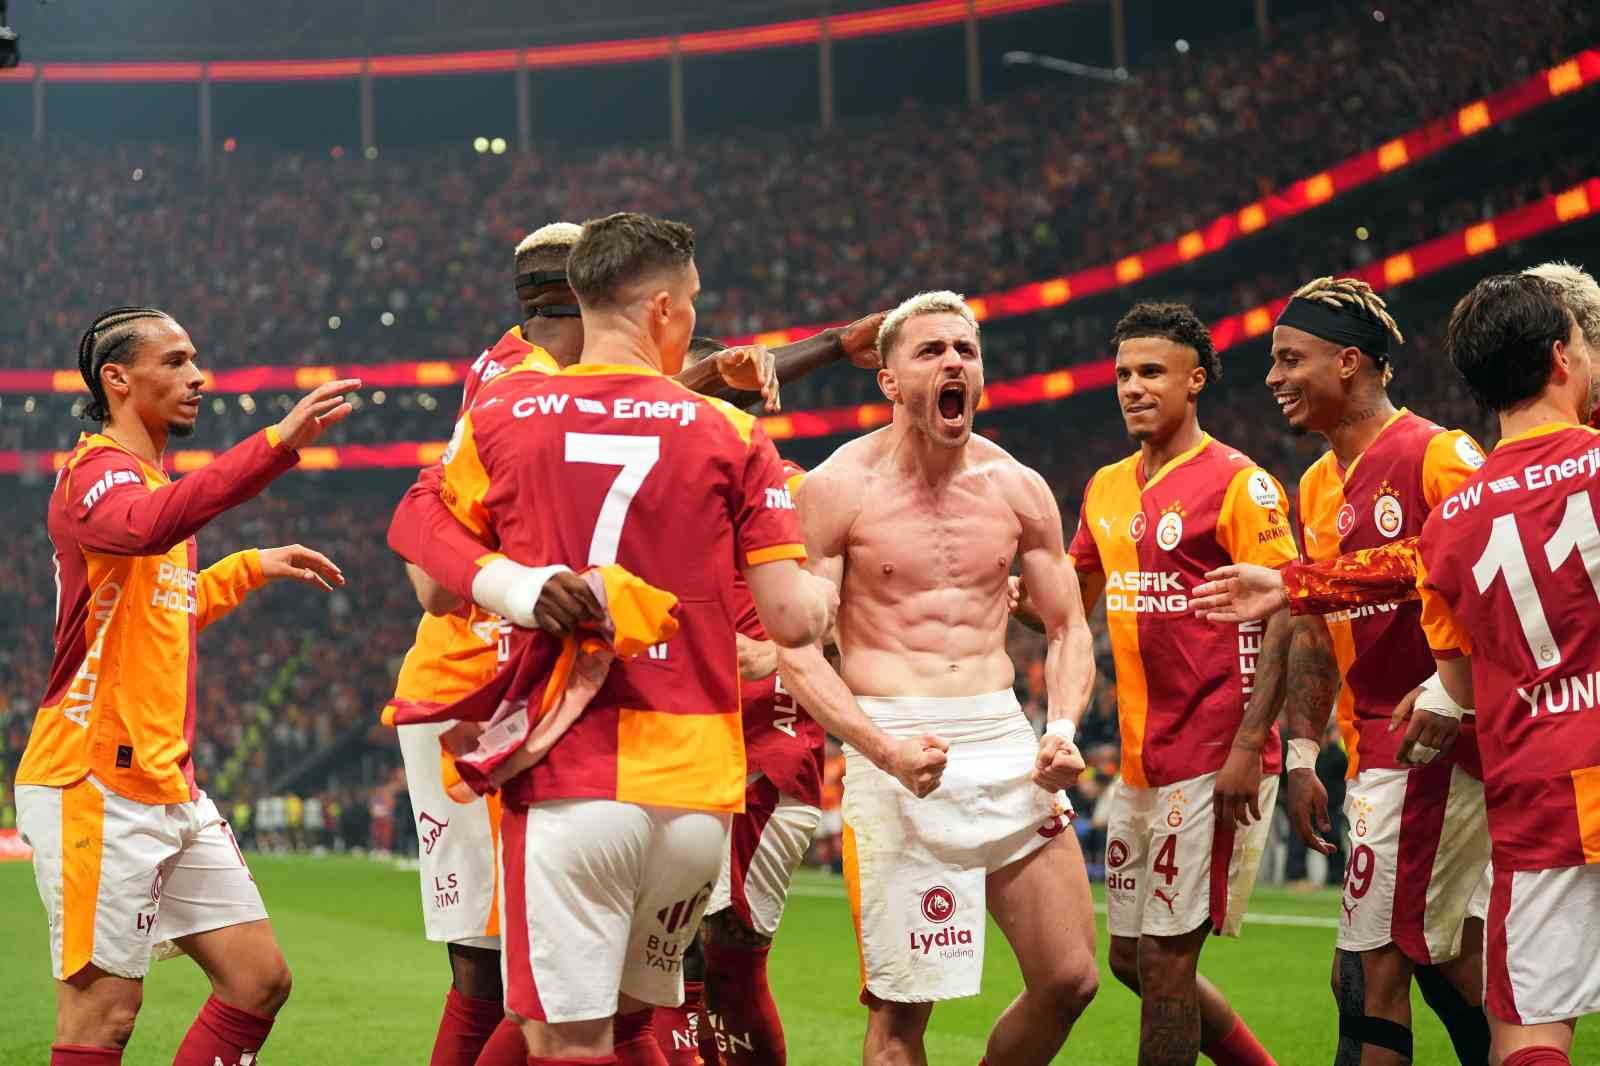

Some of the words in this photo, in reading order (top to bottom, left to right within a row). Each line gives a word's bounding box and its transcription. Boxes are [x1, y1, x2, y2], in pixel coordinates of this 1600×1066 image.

[512, 393, 569, 418] CW
[613, 398, 696, 426] Enerji
[564, 432, 661, 567] 7
[1442, 482, 1484, 520] CW
[1524, 447, 1600, 491] Enerji
[1153, 834, 1179, 886] 4
[1343, 844, 1375, 899] 9
[910, 926, 973, 955] Lydia
